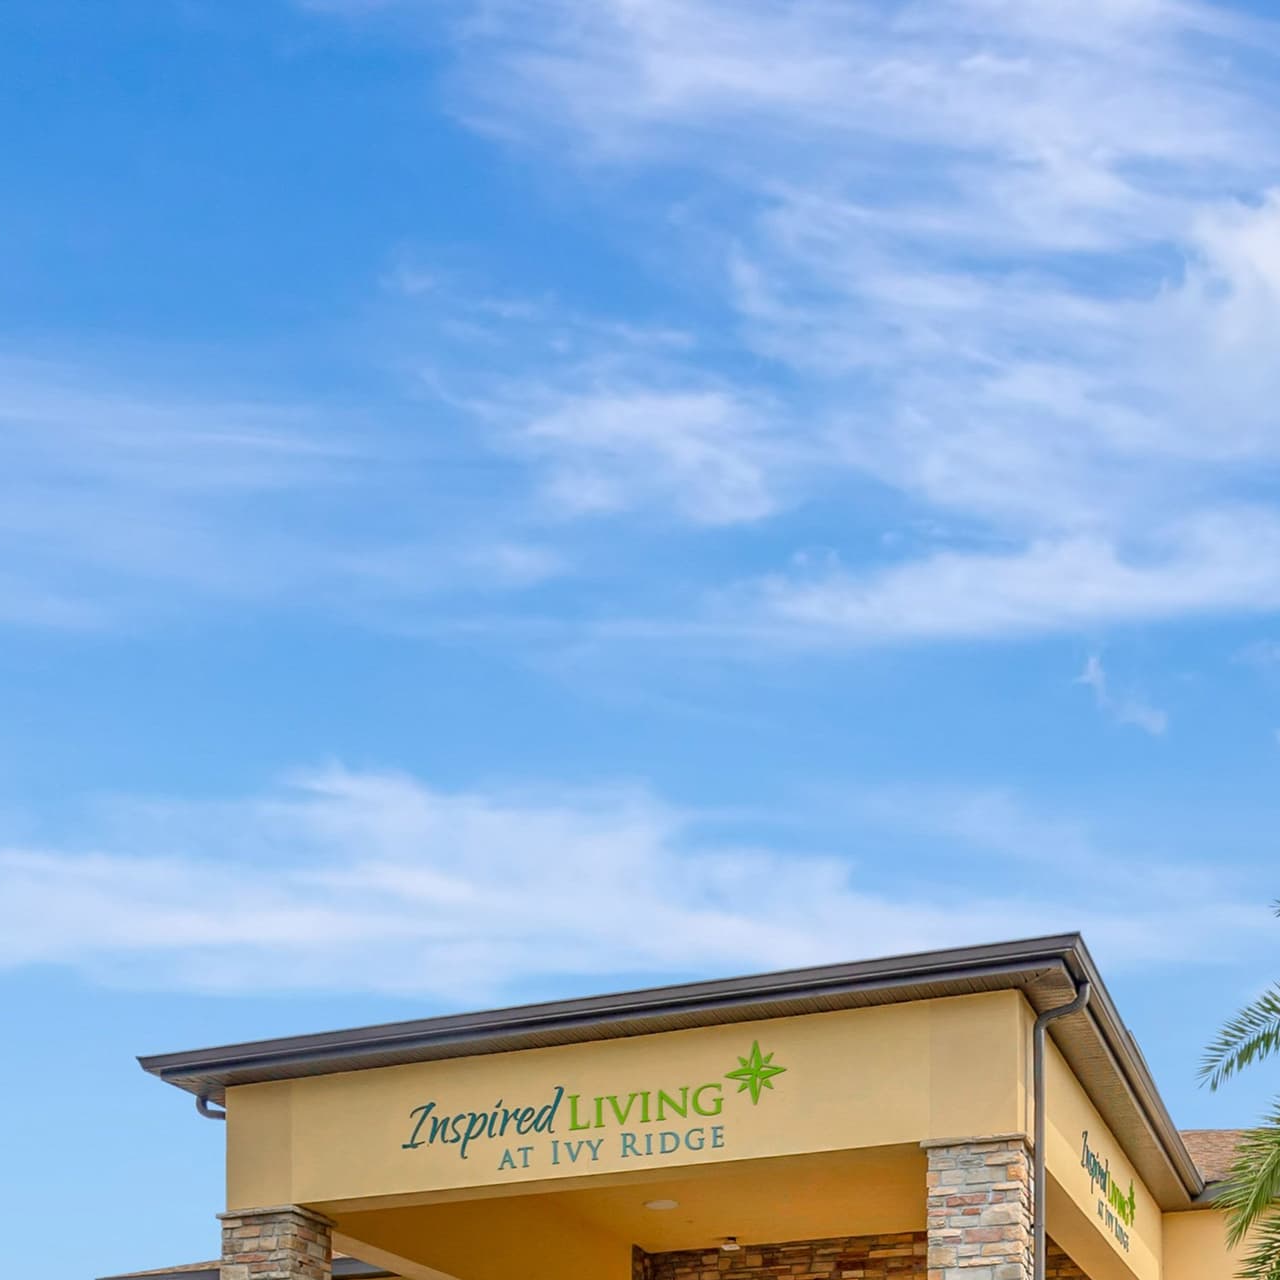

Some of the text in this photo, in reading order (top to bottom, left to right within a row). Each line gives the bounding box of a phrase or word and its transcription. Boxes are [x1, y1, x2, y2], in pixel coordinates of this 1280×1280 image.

[401, 1083, 725, 1160] Inspired LIVING
[497, 1125, 725, 1170] AT IVY RIDGE
